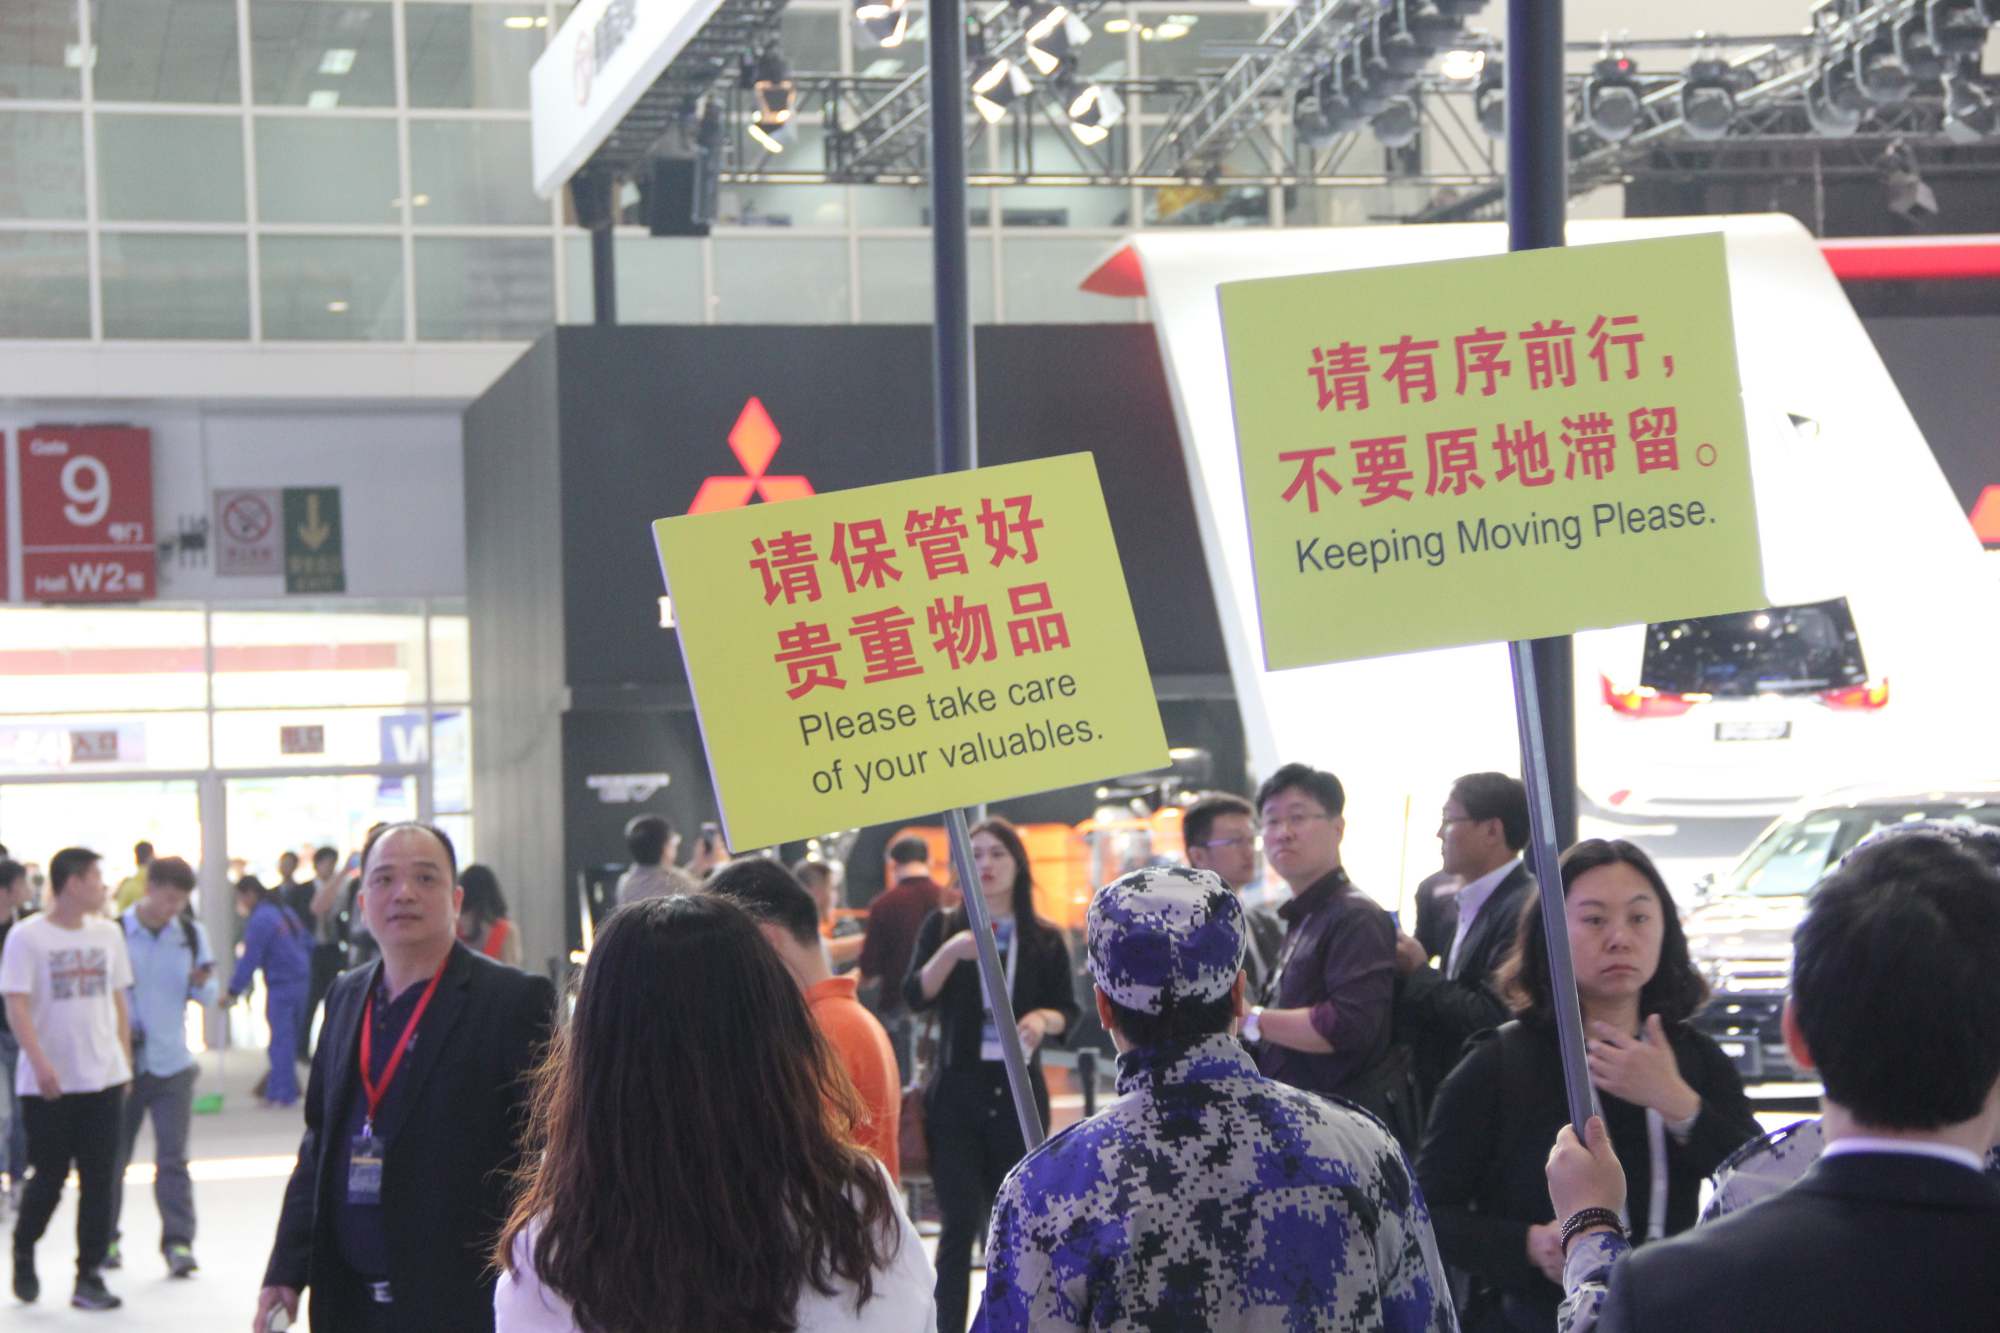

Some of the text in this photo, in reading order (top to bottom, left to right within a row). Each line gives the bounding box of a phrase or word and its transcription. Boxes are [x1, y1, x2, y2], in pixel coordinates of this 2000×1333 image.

[60, 455, 111, 527] 9
[1278, 406, 1718, 513] 不要原地滞留。
[749, 494, 1045, 606] 请保管好
[1296, 500, 1717, 573] Keeping Moving Please.
[68, 562, 125, 592] W2
[773, 581, 1072, 700] 贵重物品
[799, 674, 1077, 746] Please take care
[812, 717, 1104, 794] of your valuables.
